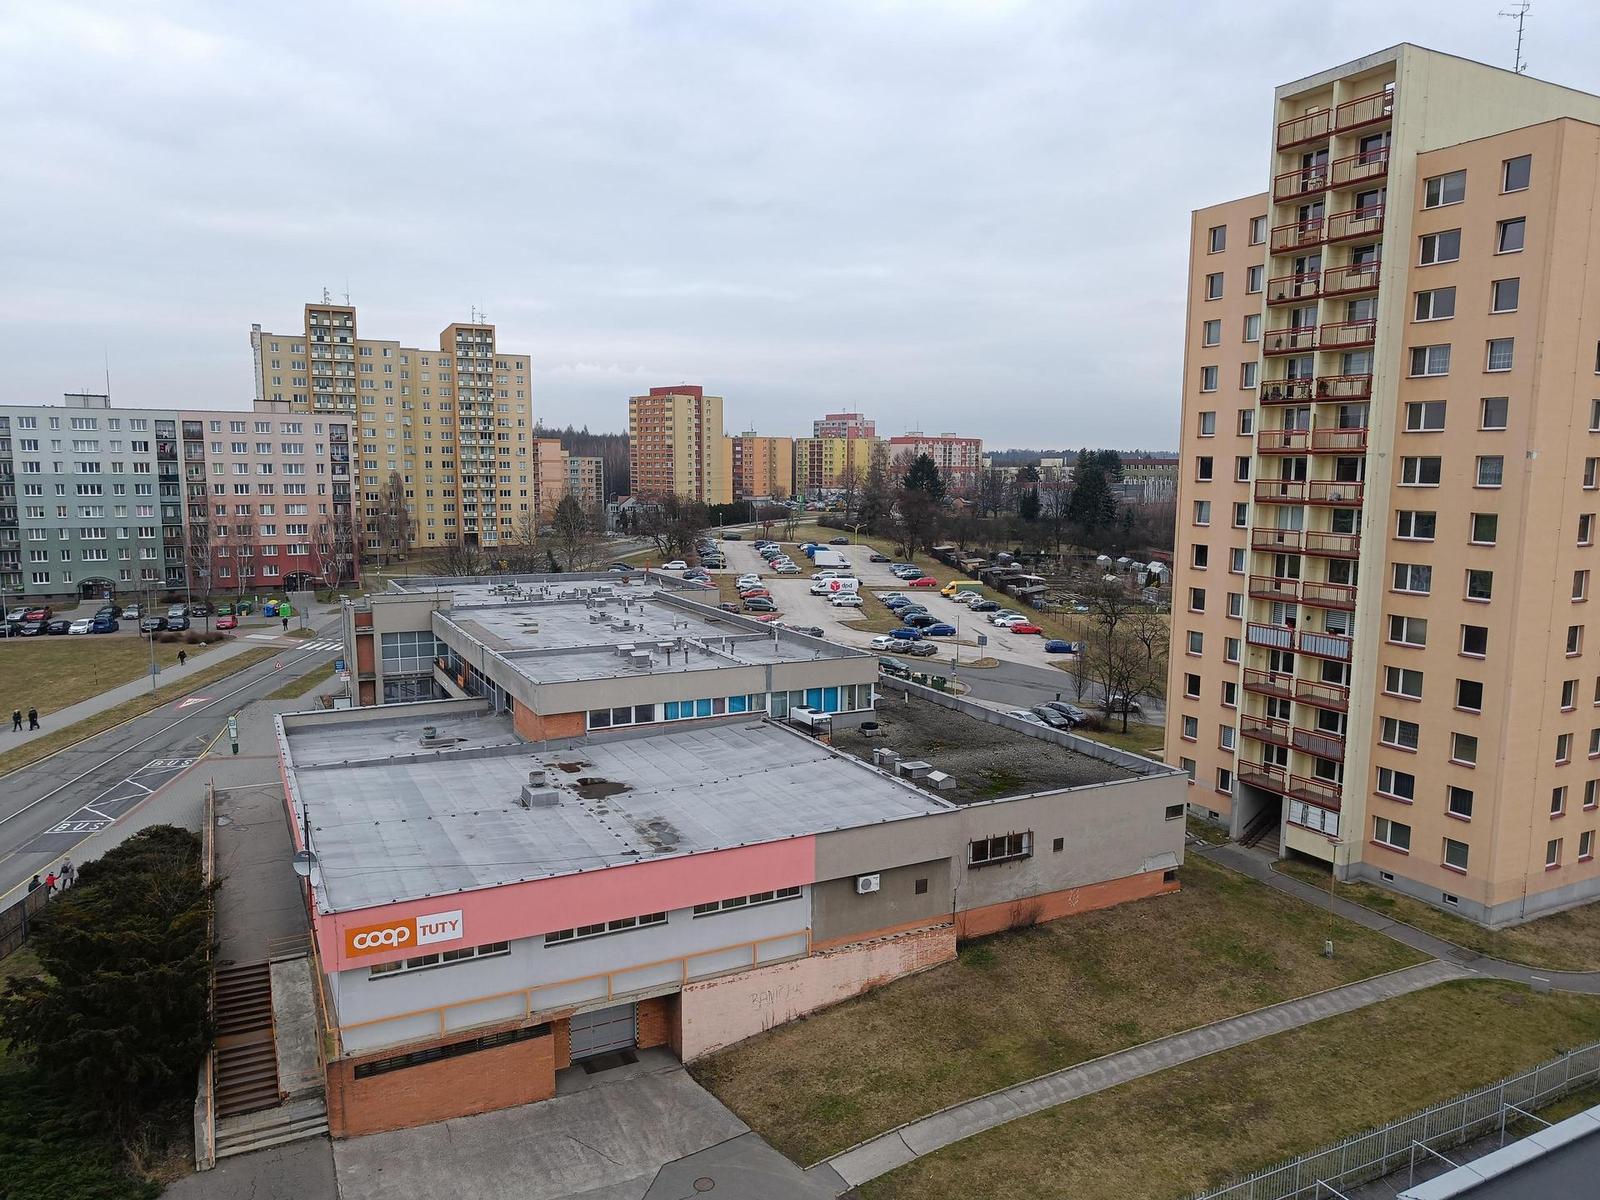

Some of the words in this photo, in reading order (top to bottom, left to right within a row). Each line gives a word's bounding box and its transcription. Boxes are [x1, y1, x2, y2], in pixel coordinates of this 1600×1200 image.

[54, 822, 104, 832] BUS
[353, 926, 411, 949] coop
[419, 919, 459, 937] TUTY
